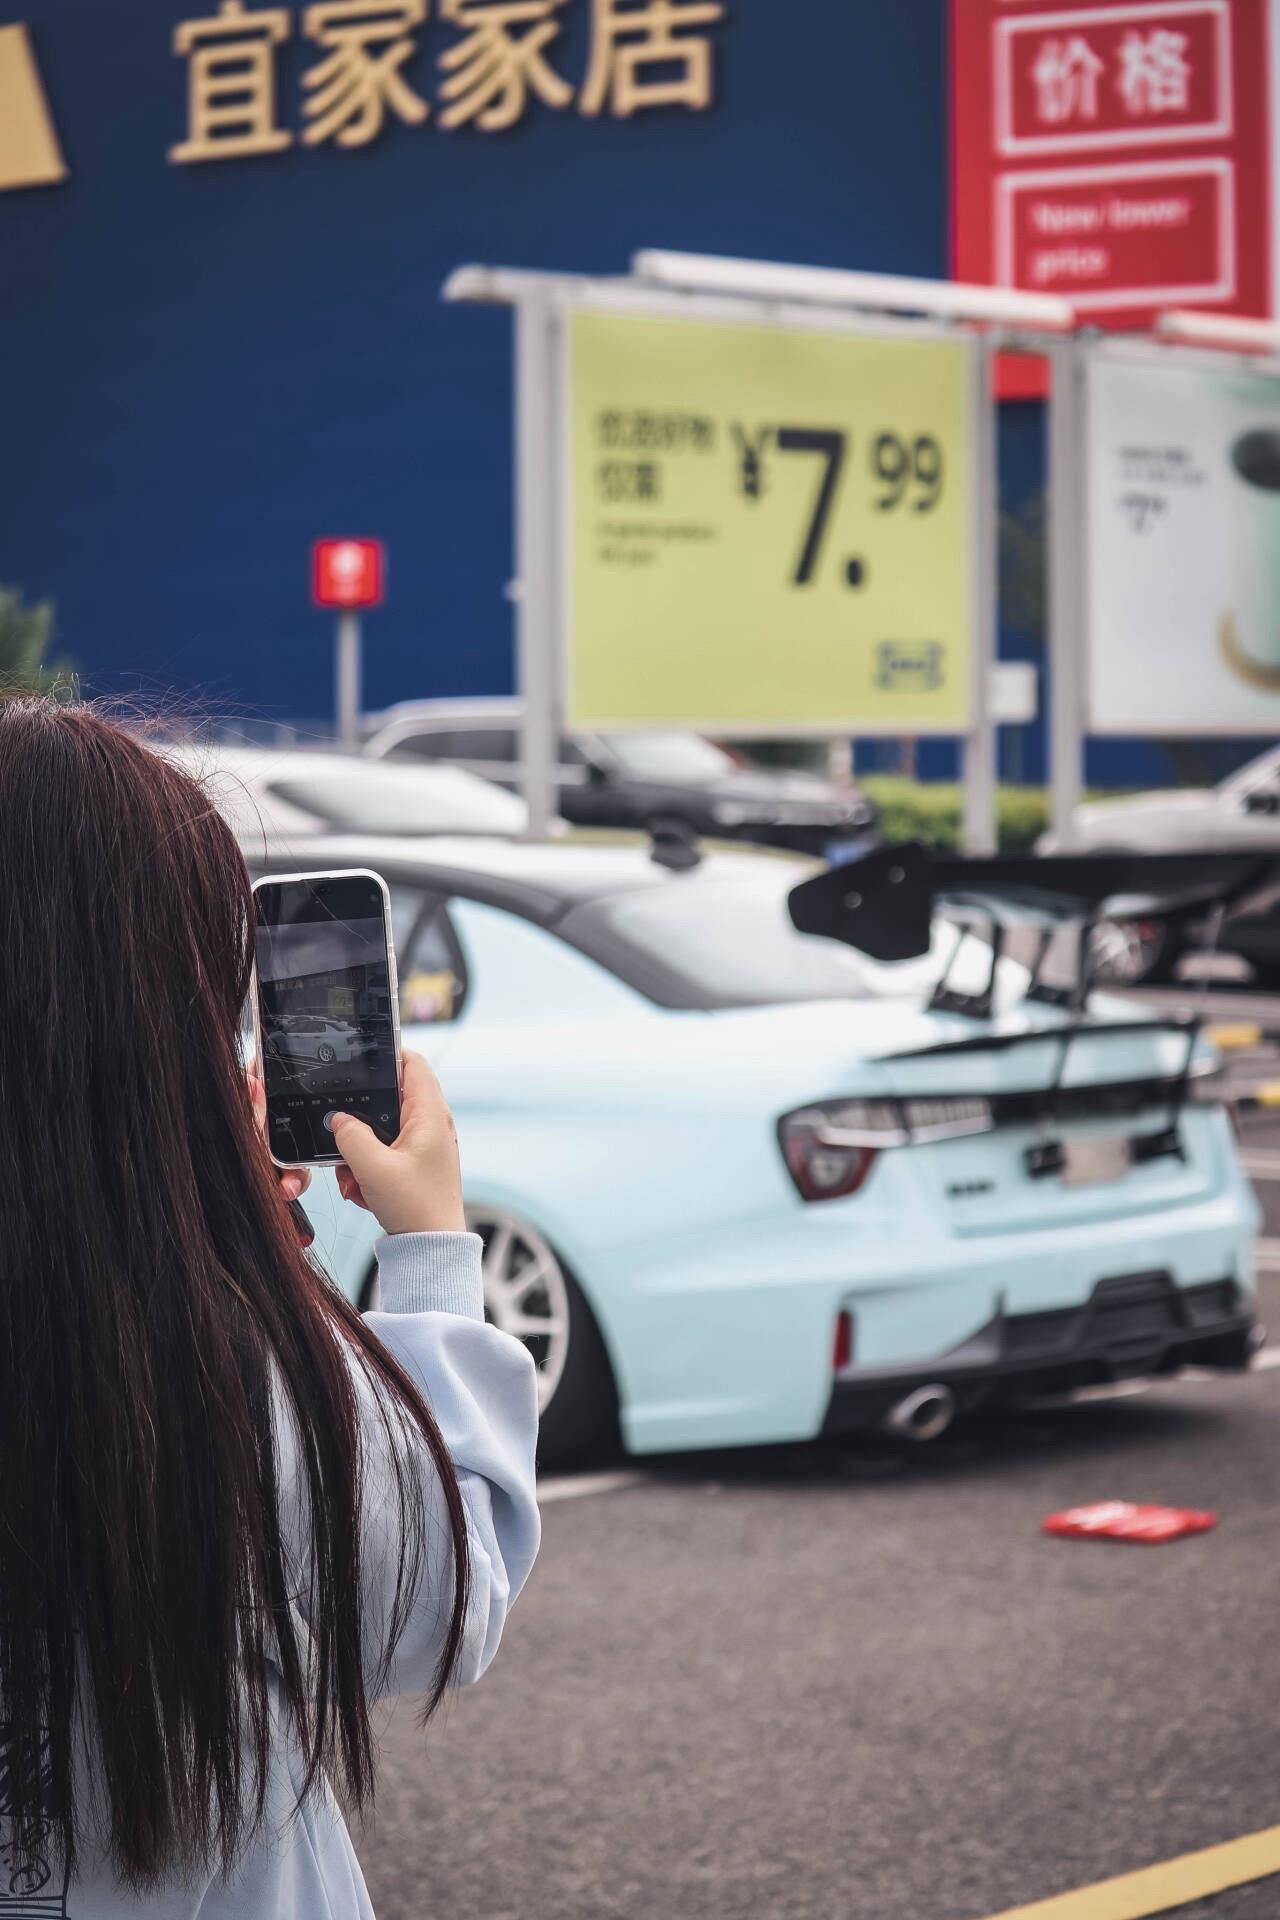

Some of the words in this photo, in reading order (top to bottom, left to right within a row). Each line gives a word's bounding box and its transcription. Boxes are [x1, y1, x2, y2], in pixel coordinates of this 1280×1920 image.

[168, 0, 723, 163] 宜家家居
[1032, 28, 1190, 123] 价格
